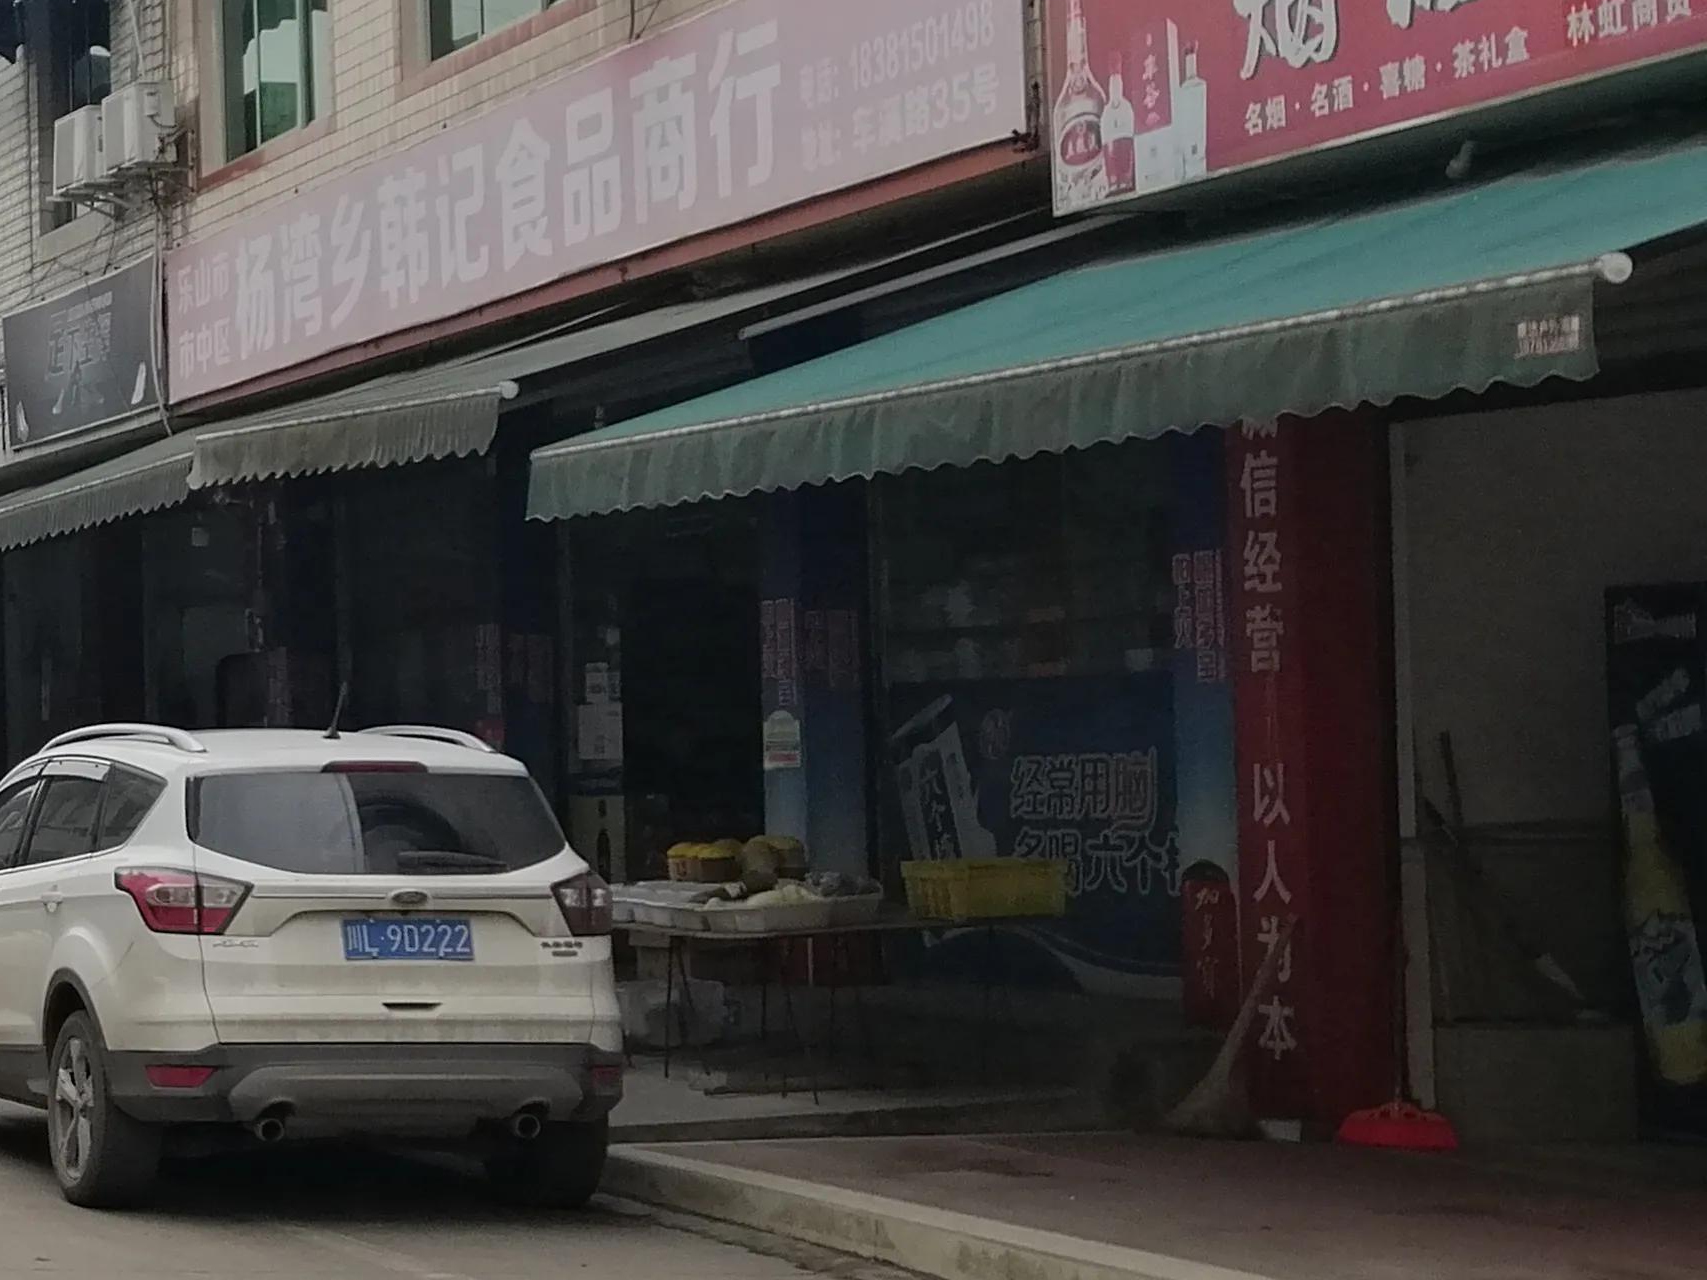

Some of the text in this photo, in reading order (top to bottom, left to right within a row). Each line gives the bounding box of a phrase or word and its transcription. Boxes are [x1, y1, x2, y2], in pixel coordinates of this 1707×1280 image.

[235, 17, 783, 362] 杨湾乡韩记食品商行
[178, 317, 231, 380] 市中区
